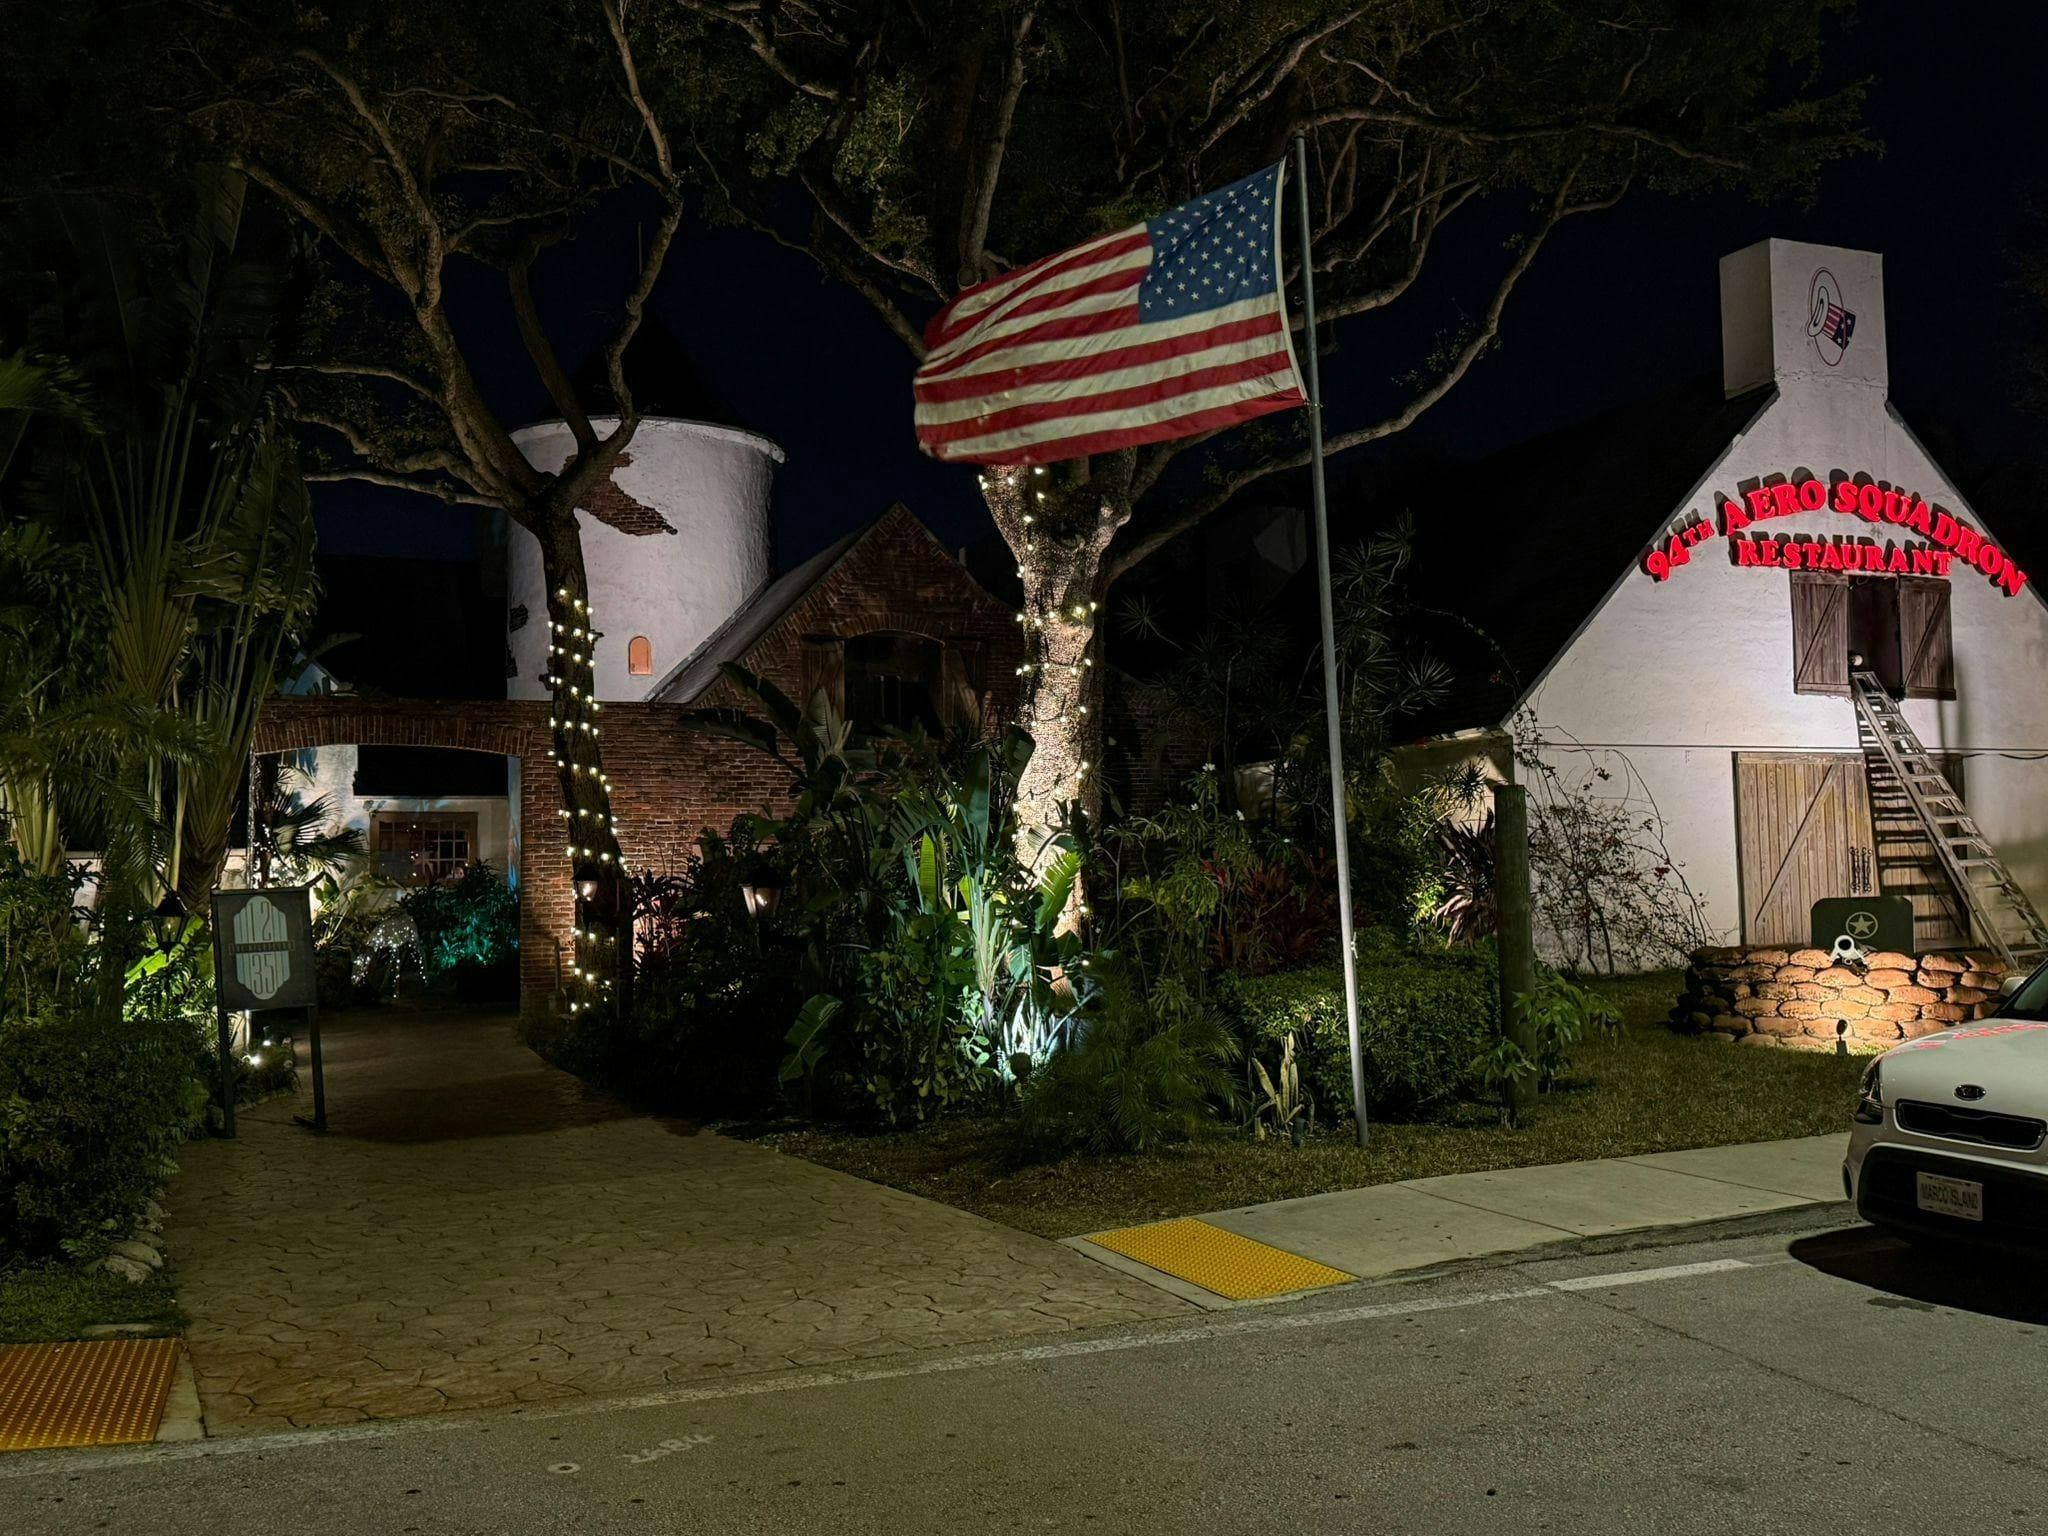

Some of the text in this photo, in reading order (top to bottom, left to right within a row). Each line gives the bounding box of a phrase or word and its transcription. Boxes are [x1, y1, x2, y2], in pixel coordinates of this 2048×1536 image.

[1646, 480, 2028, 597] 94TH AERO SQUADRON
[1737, 539, 1952, 576] RESTAURANT
[252, 953, 275, 994] 35
